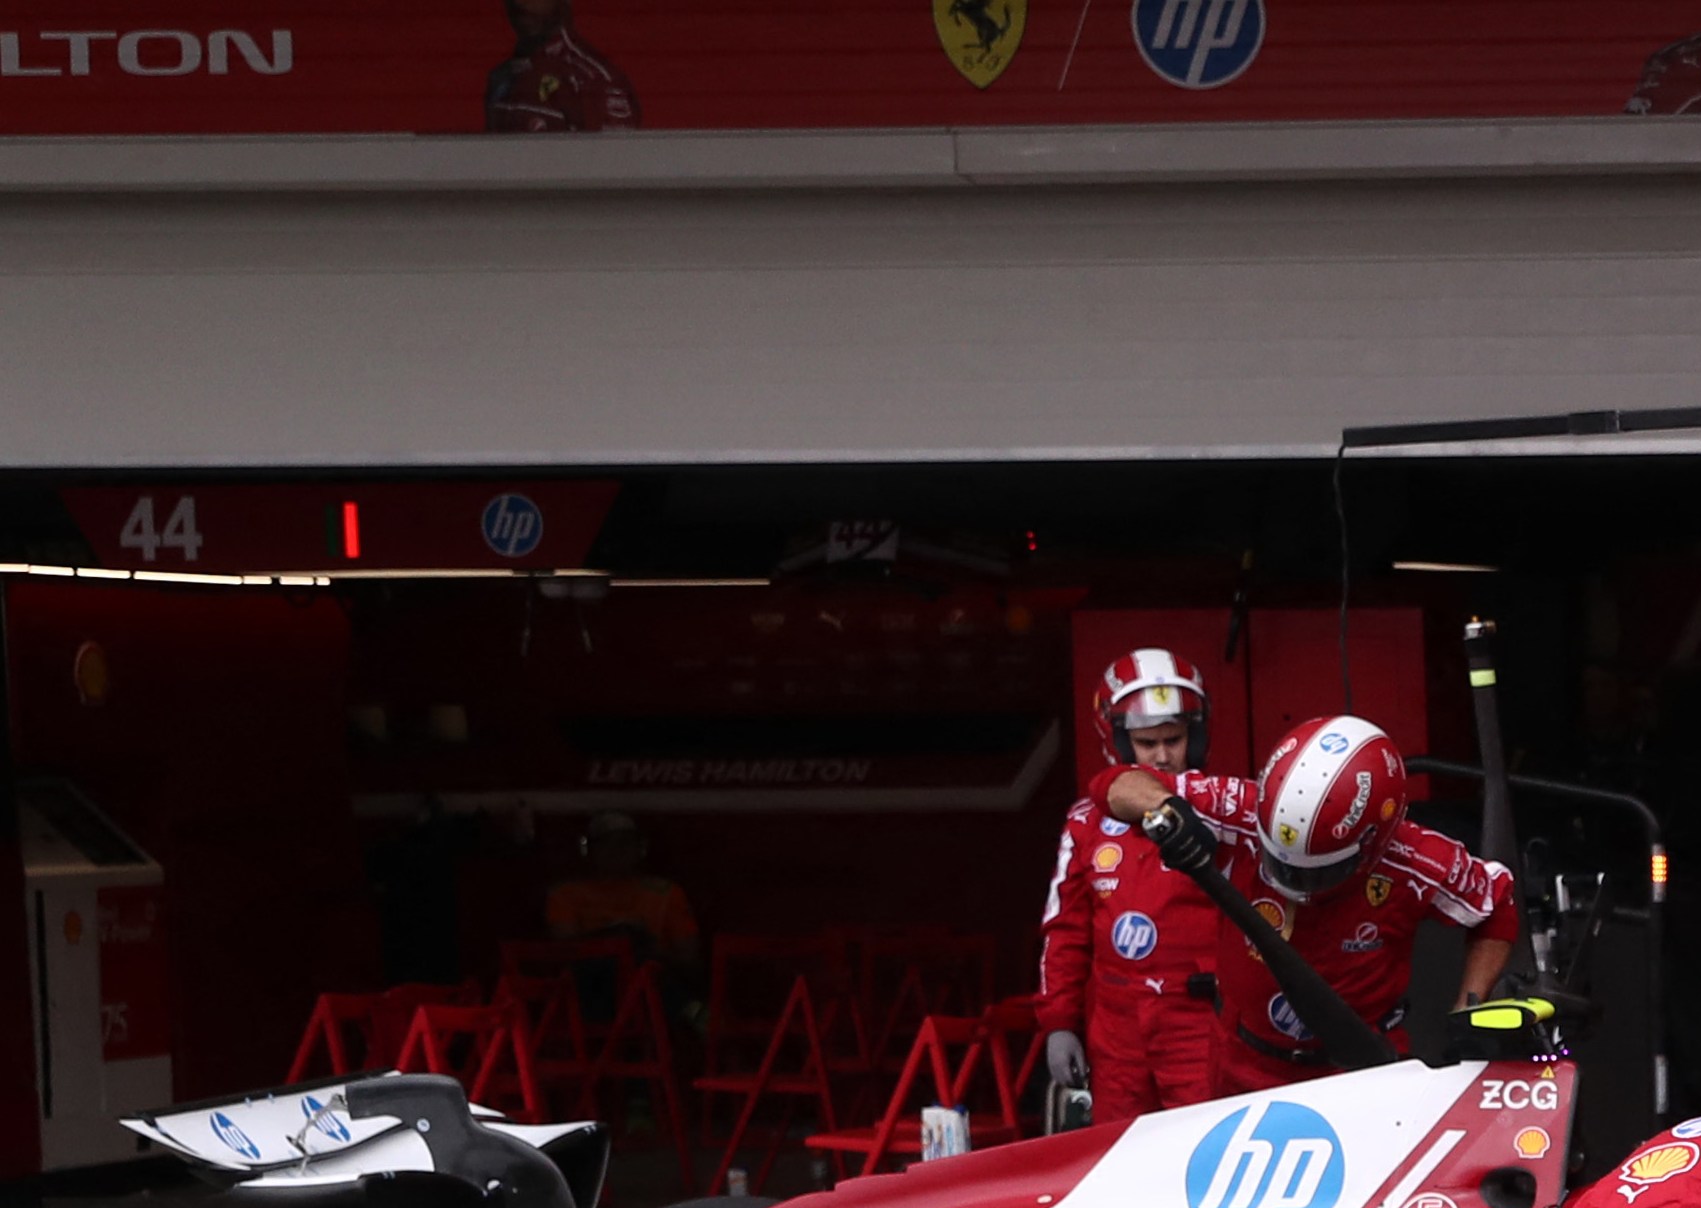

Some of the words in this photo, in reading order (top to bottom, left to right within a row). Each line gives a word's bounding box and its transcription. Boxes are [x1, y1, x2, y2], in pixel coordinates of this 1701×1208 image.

[119, 496, 202, 562] 44
[487, 494, 540, 556] hp
[1343, 770, 1373, 830] UniCredit
[1114, 911, 1157, 960] hp
[1479, 1079, 1559, 1111] ZCG
